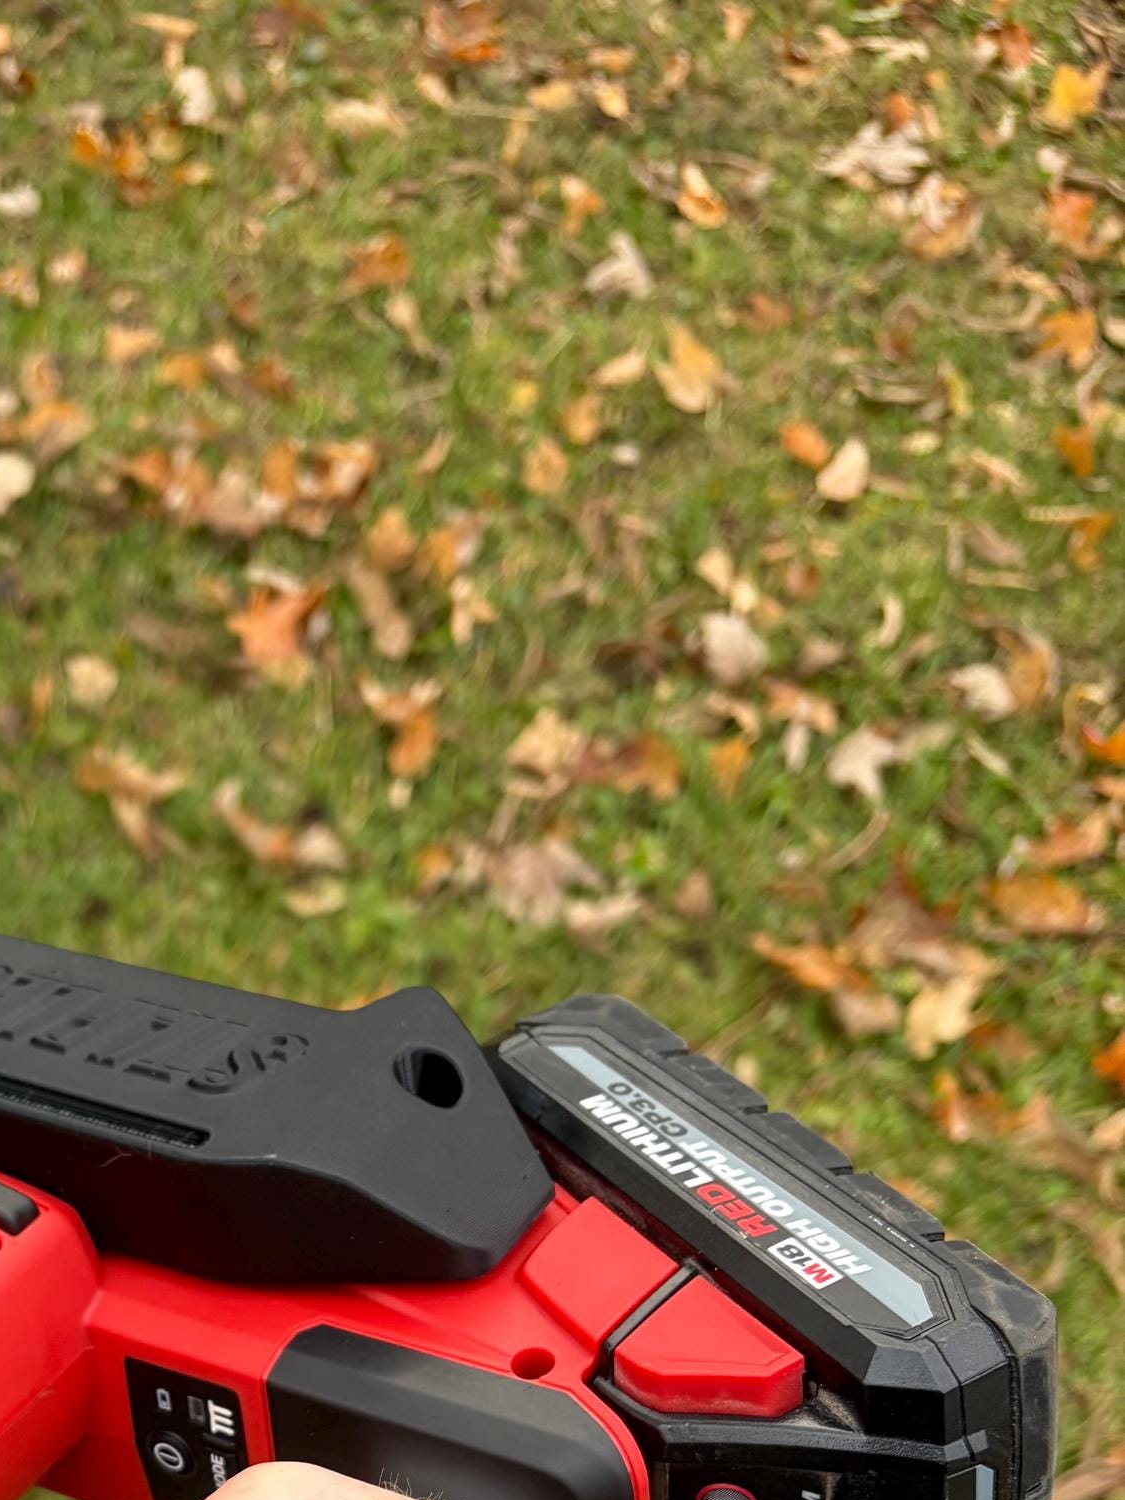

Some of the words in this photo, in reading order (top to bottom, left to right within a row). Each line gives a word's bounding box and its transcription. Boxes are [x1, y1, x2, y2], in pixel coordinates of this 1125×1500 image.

[607, 1082, 688, 1138] CP3.0
[579, 1094, 777, 1238] REDLITHIUM
[681, 1141, 794, 1217] OUTPUT
[776, 1242, 835, 1285] M18
[785, 1218, 873, 1275] HIGH
[210, 1453, 226, 1488] ODE
